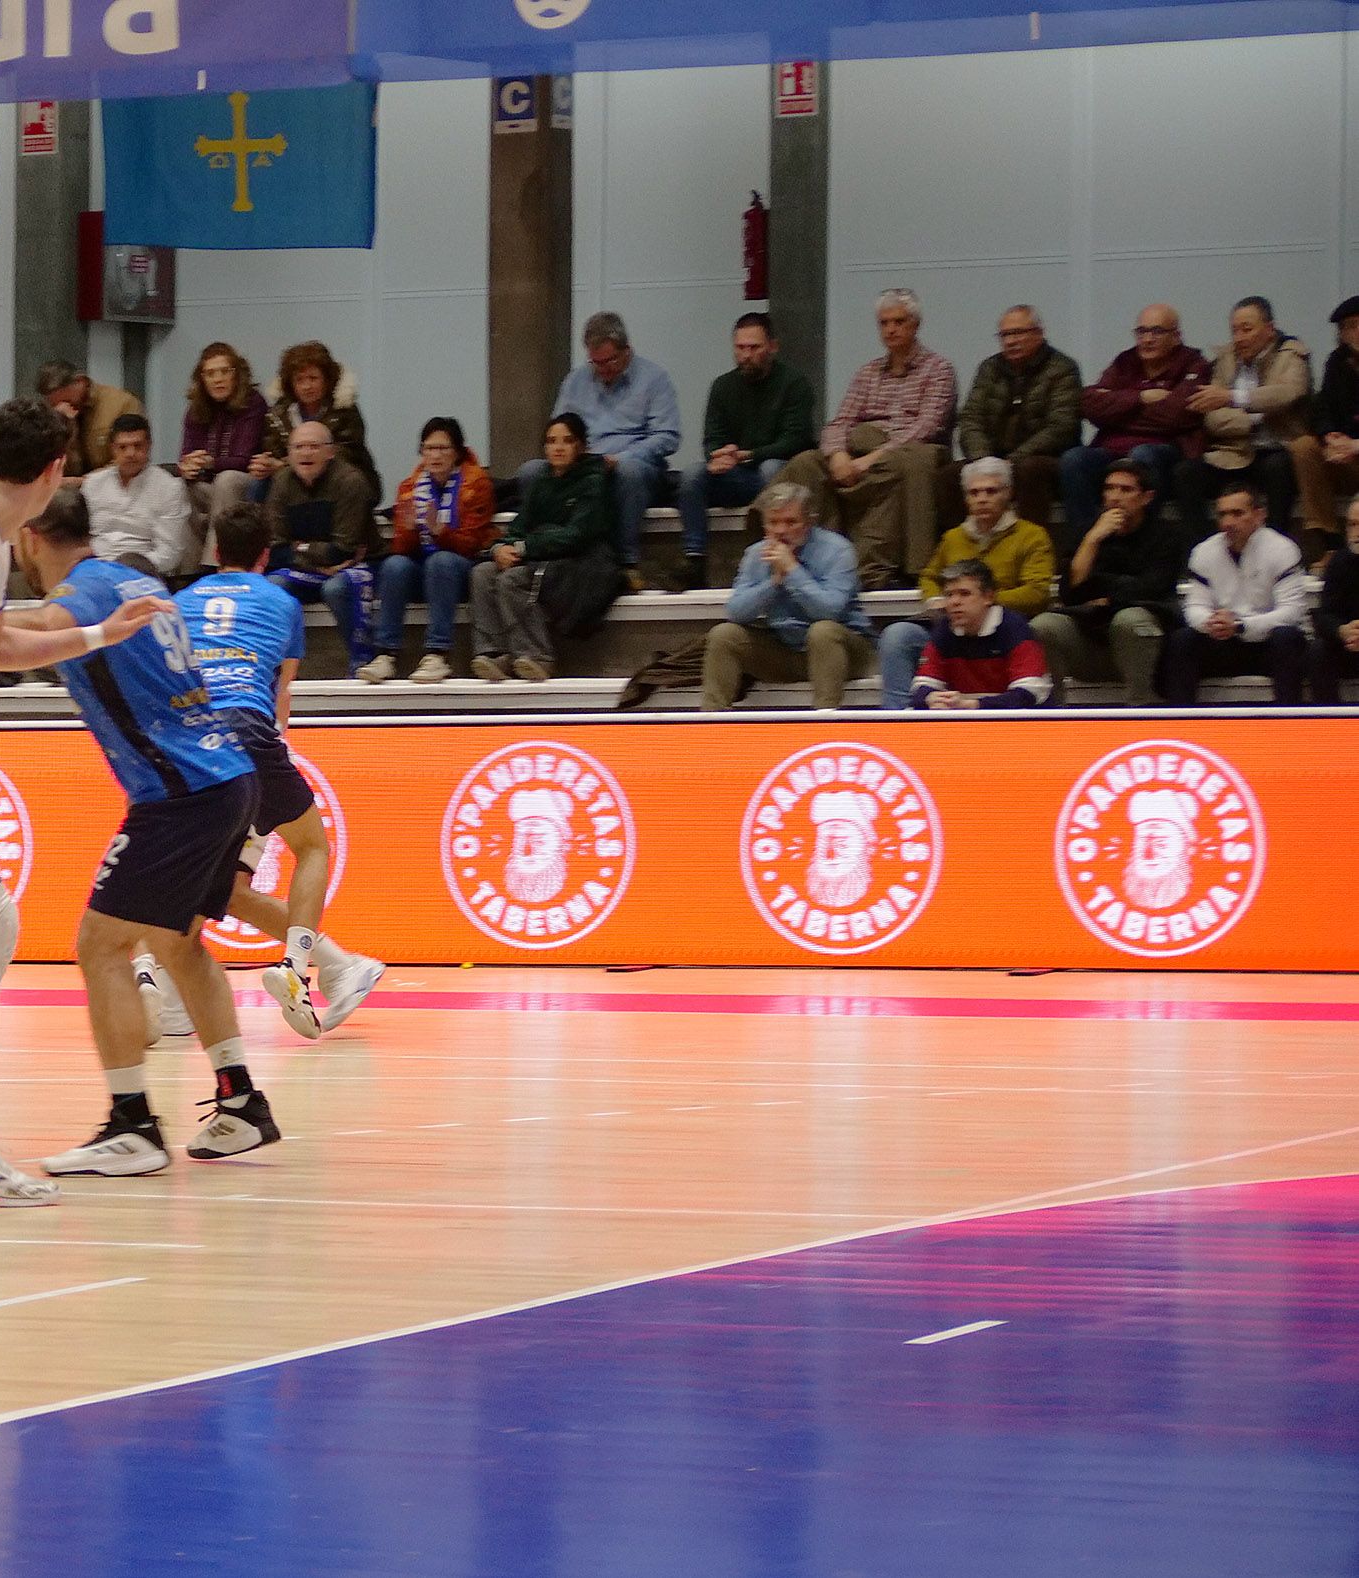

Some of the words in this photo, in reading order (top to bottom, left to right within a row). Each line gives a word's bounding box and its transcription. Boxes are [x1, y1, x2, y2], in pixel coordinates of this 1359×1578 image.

[500, 81, 531, 114] C
[203, 596, 236, 636] 9
[451, 753, 625, 859] O'PANDERETAS
[751, 755, 932, 862] O'PANDERETAS
[1067, 753, 1254, 863] O'PANDERETAS
[468, 881, 613, 937] TABERNA
[769, 884, 920, 942] TABERNA
[1086, 885, 1241, 944] TABERNA
